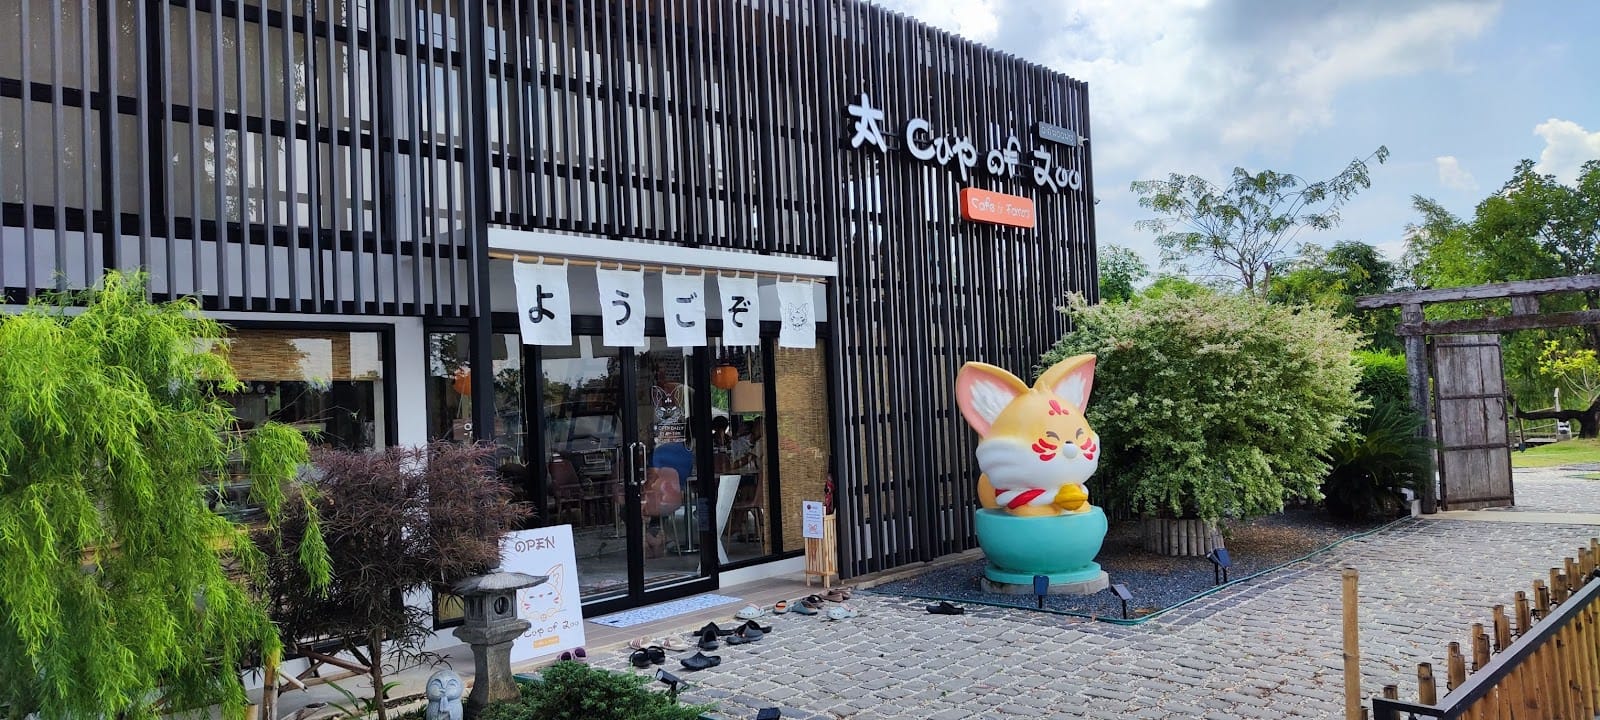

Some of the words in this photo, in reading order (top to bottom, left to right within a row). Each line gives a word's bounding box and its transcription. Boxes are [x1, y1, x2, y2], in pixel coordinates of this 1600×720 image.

[906, 118, 977, 182] Cup
[987, 135, 1021, 178] of
[1033, 145, 1081, 193] Zoo
[515, 536, 555, 552] OPEN
[523, 628, 545, 638] Cup
[547, 621, 559, 632] of
